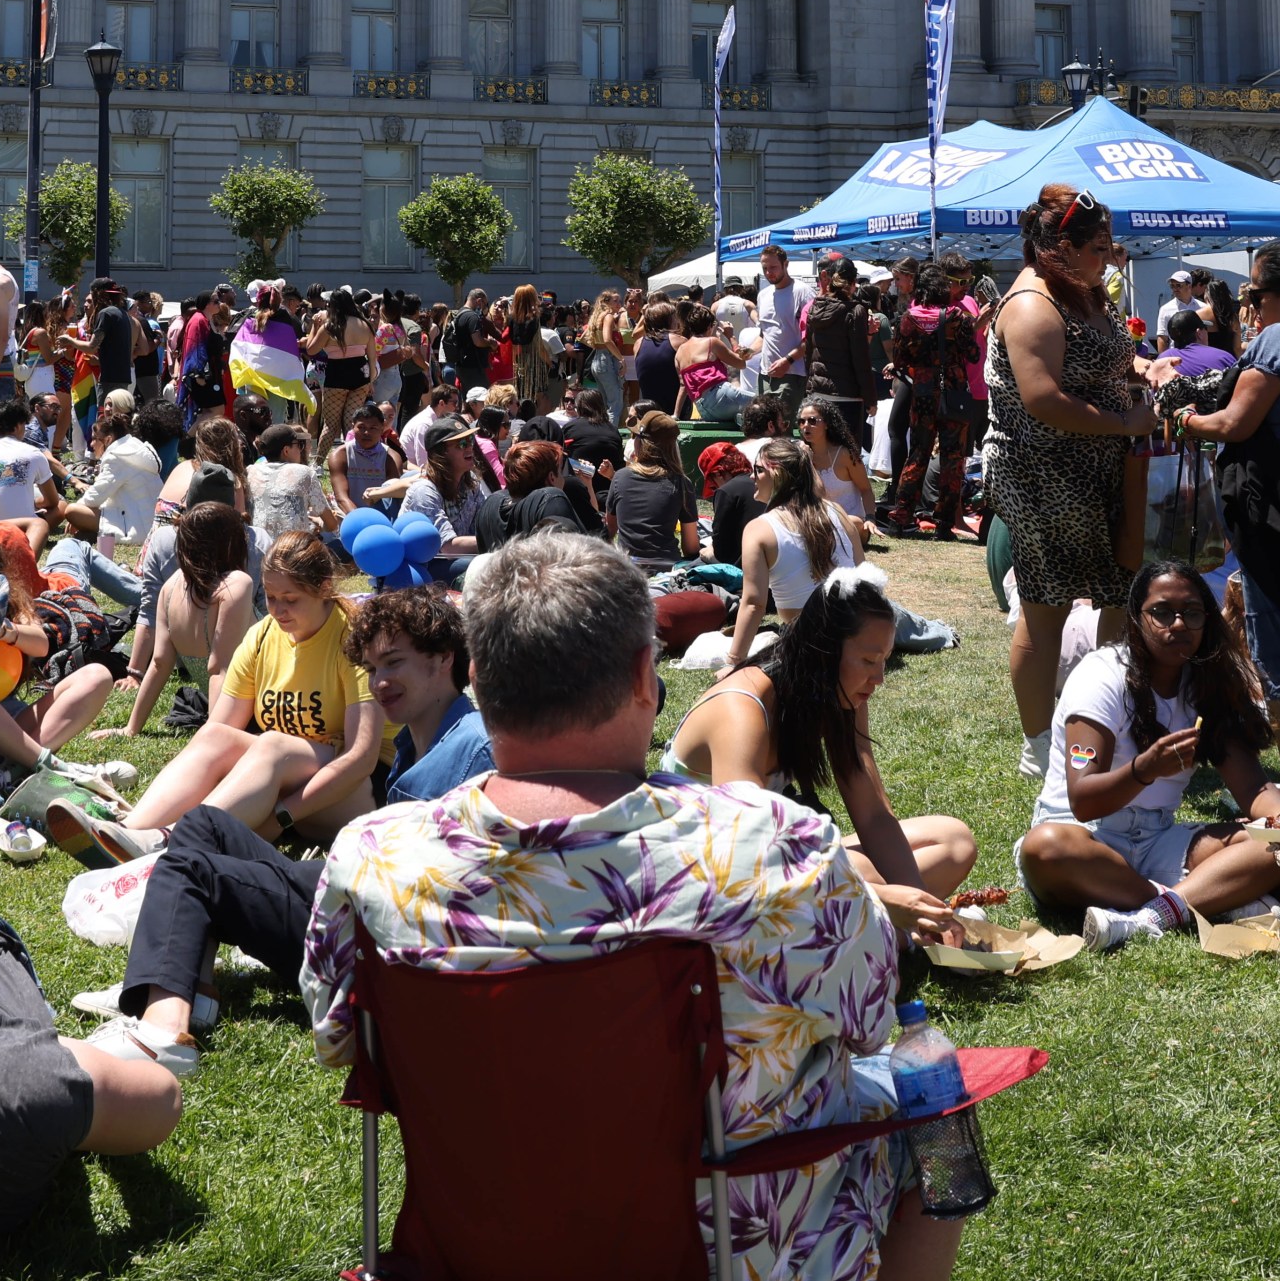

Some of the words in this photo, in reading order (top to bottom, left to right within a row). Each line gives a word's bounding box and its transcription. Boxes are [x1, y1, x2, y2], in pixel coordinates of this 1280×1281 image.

[1096, 141, 1175, 163] BUD
[1095, 158, 1199, 183] LIGHT
[867, 215, 889, 234] BUD
[889, 211, 919, 232] LIGHT
[966, 209, 1008, 226] BUD
[1132, 211, 1171, 228] BUD
[1171, 212, 1228, 230] LIGHT
[729, 236, 746, 253] BUD
[746, 231, 771, 250] LIGHT
[261, 689, 323, 712] GIRLS
